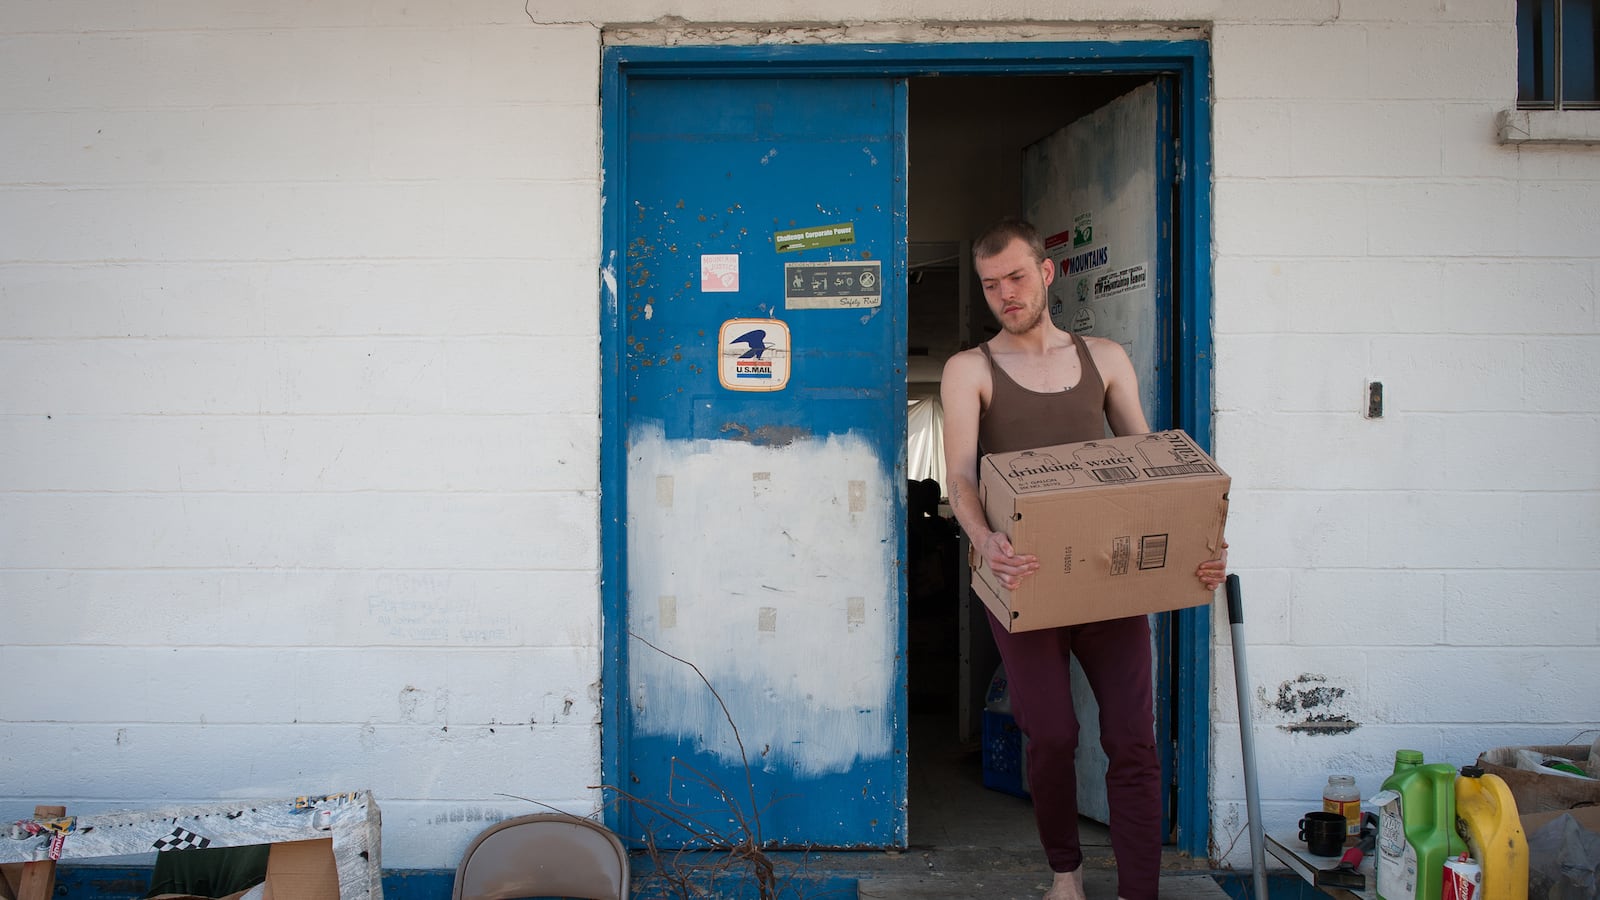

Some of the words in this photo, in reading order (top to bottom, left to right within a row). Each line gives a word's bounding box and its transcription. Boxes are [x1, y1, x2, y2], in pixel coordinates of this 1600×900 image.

[777, 233, 804, 242] Challenge
[805, 229, 833, 239] Corporate
[834, 227, 851, 235] Power
[1069, 246, 1108, 275] MOUNTAINS
[840, 298, 861, 307] Safety
[1008, 461, 1083, 478] drinking
[1085, 456, 1134, 468] water
